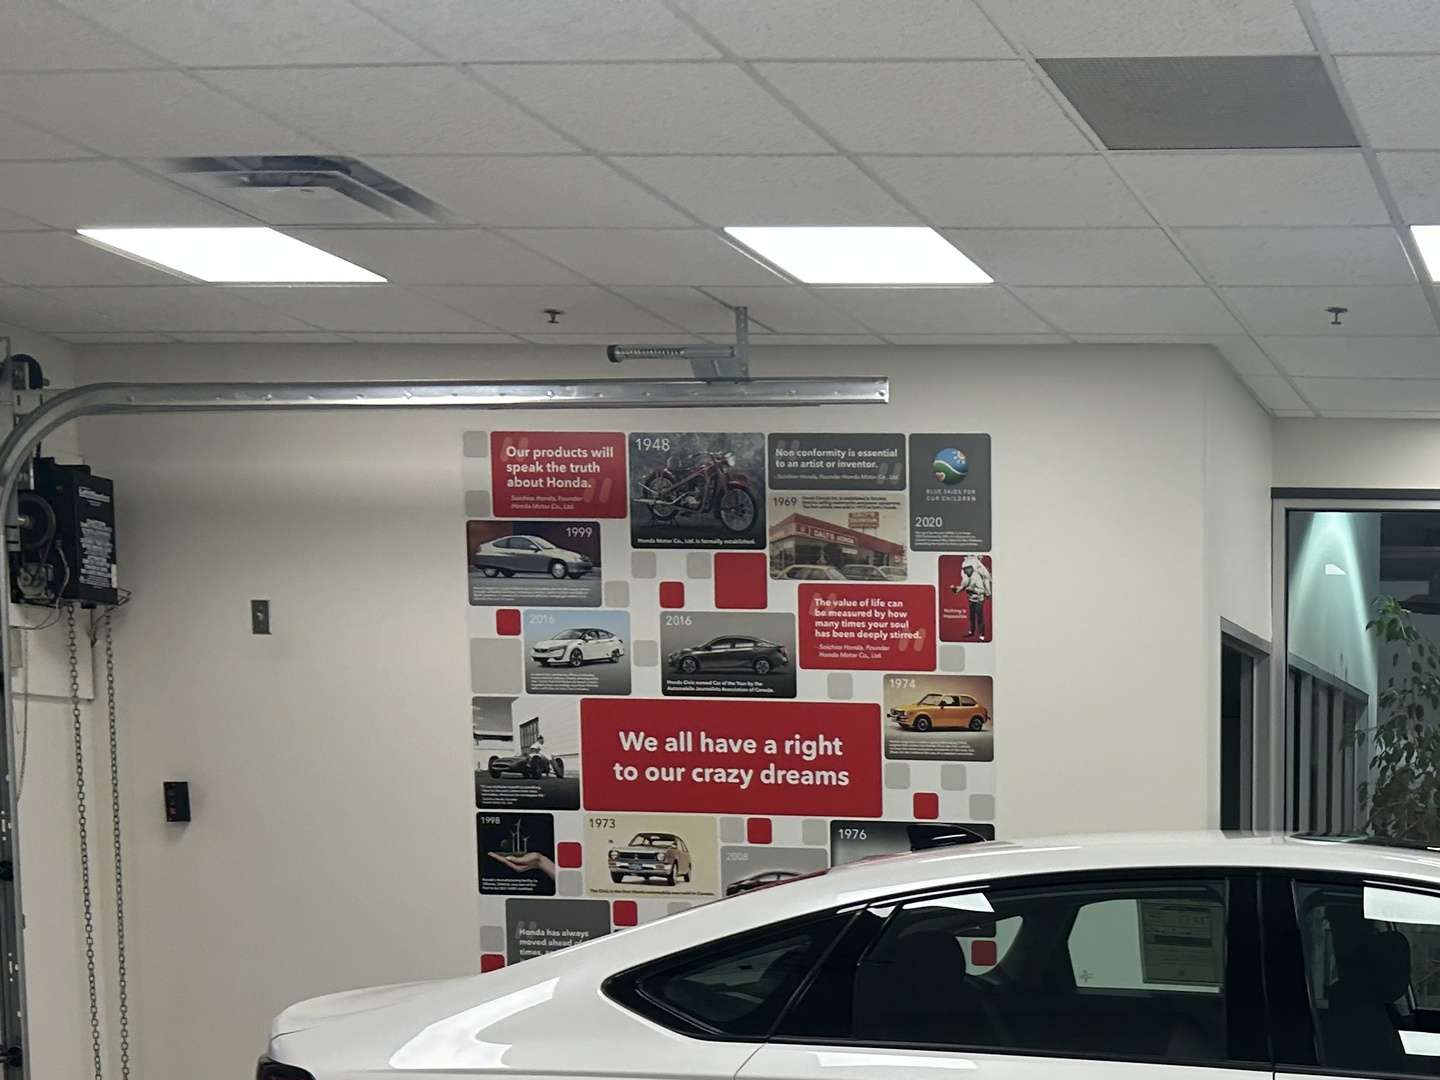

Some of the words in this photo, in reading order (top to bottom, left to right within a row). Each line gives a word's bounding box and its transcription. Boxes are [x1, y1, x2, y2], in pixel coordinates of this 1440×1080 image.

[635, 438, 670, 451] 1948
[505, 446, 530, 458] Our
[533, 446, 587, 460] products
[591, 446, 614, 458] will
[775, 448, 795, 457] Non
[796, 448, 847, 459] conformity
[848, 449, 856, 457] is
[857, 448, 898, 457] essential
[506, 462, 543, 475] speak
[546, 461, 567, 473] the
[570, 461, 600, 473] truth
[775, 460, 785, 468] to
[800, 460, 824, 469] artist
[826, 461, 836, 469] or
[837, 460, 879, 469] inventor.
[506, 476, 544, 488] about
[546, 477, 592, 488] Honda.
[773, 497, 798, 507] 1969
[915, 516, 943, 528] 2020
[566, 527, 593, 538] 1999
[813, 598, 831, 607] The
[833, 598, 858, 607] value
[859, 598, 870, 607] of
[870, 598, 886, 607] life
[887, 600, 903, 608] can
[814, 609, 827, 617] be
[828, 609, 873, 618] measured
[874, 610, 885, 620] by
[887, 610, 908, 618] how
[665, 615, 693, 626] 2016
[814, 620, 840, 630] many
[841, 620, 866, 628] times
[867, 622, 889, 630] your
[890, 621, 909, 629] soul
[815, 630, 831, 638] has
[832, 630, 855, 638] been
[857, 631, 888, 640] deeply
[889, 631, 922, 640] stirred.
[889, 678, 916, 689] 1974
[619, 731, 659, 752] We
[664, 731, 693, 753] all
[699, 731, 757, 754] have
[763, 738, 777, 755] a
[784, 734, 843, 761] right
[613, 763, 638, 781] to
[644, 766, 686, 782] our
[691, 767, 753, 790] crazy
[759, 763, 850, 786] dreams
[480, 816, 501, 825] 1998
[589, 818, 616, 829] 1973
[838, 828, 867, 840] 1976
[519, 928, 545, 936] Honda
[546, 928, 560, 936] has
[561, 929, 590, 938] always
